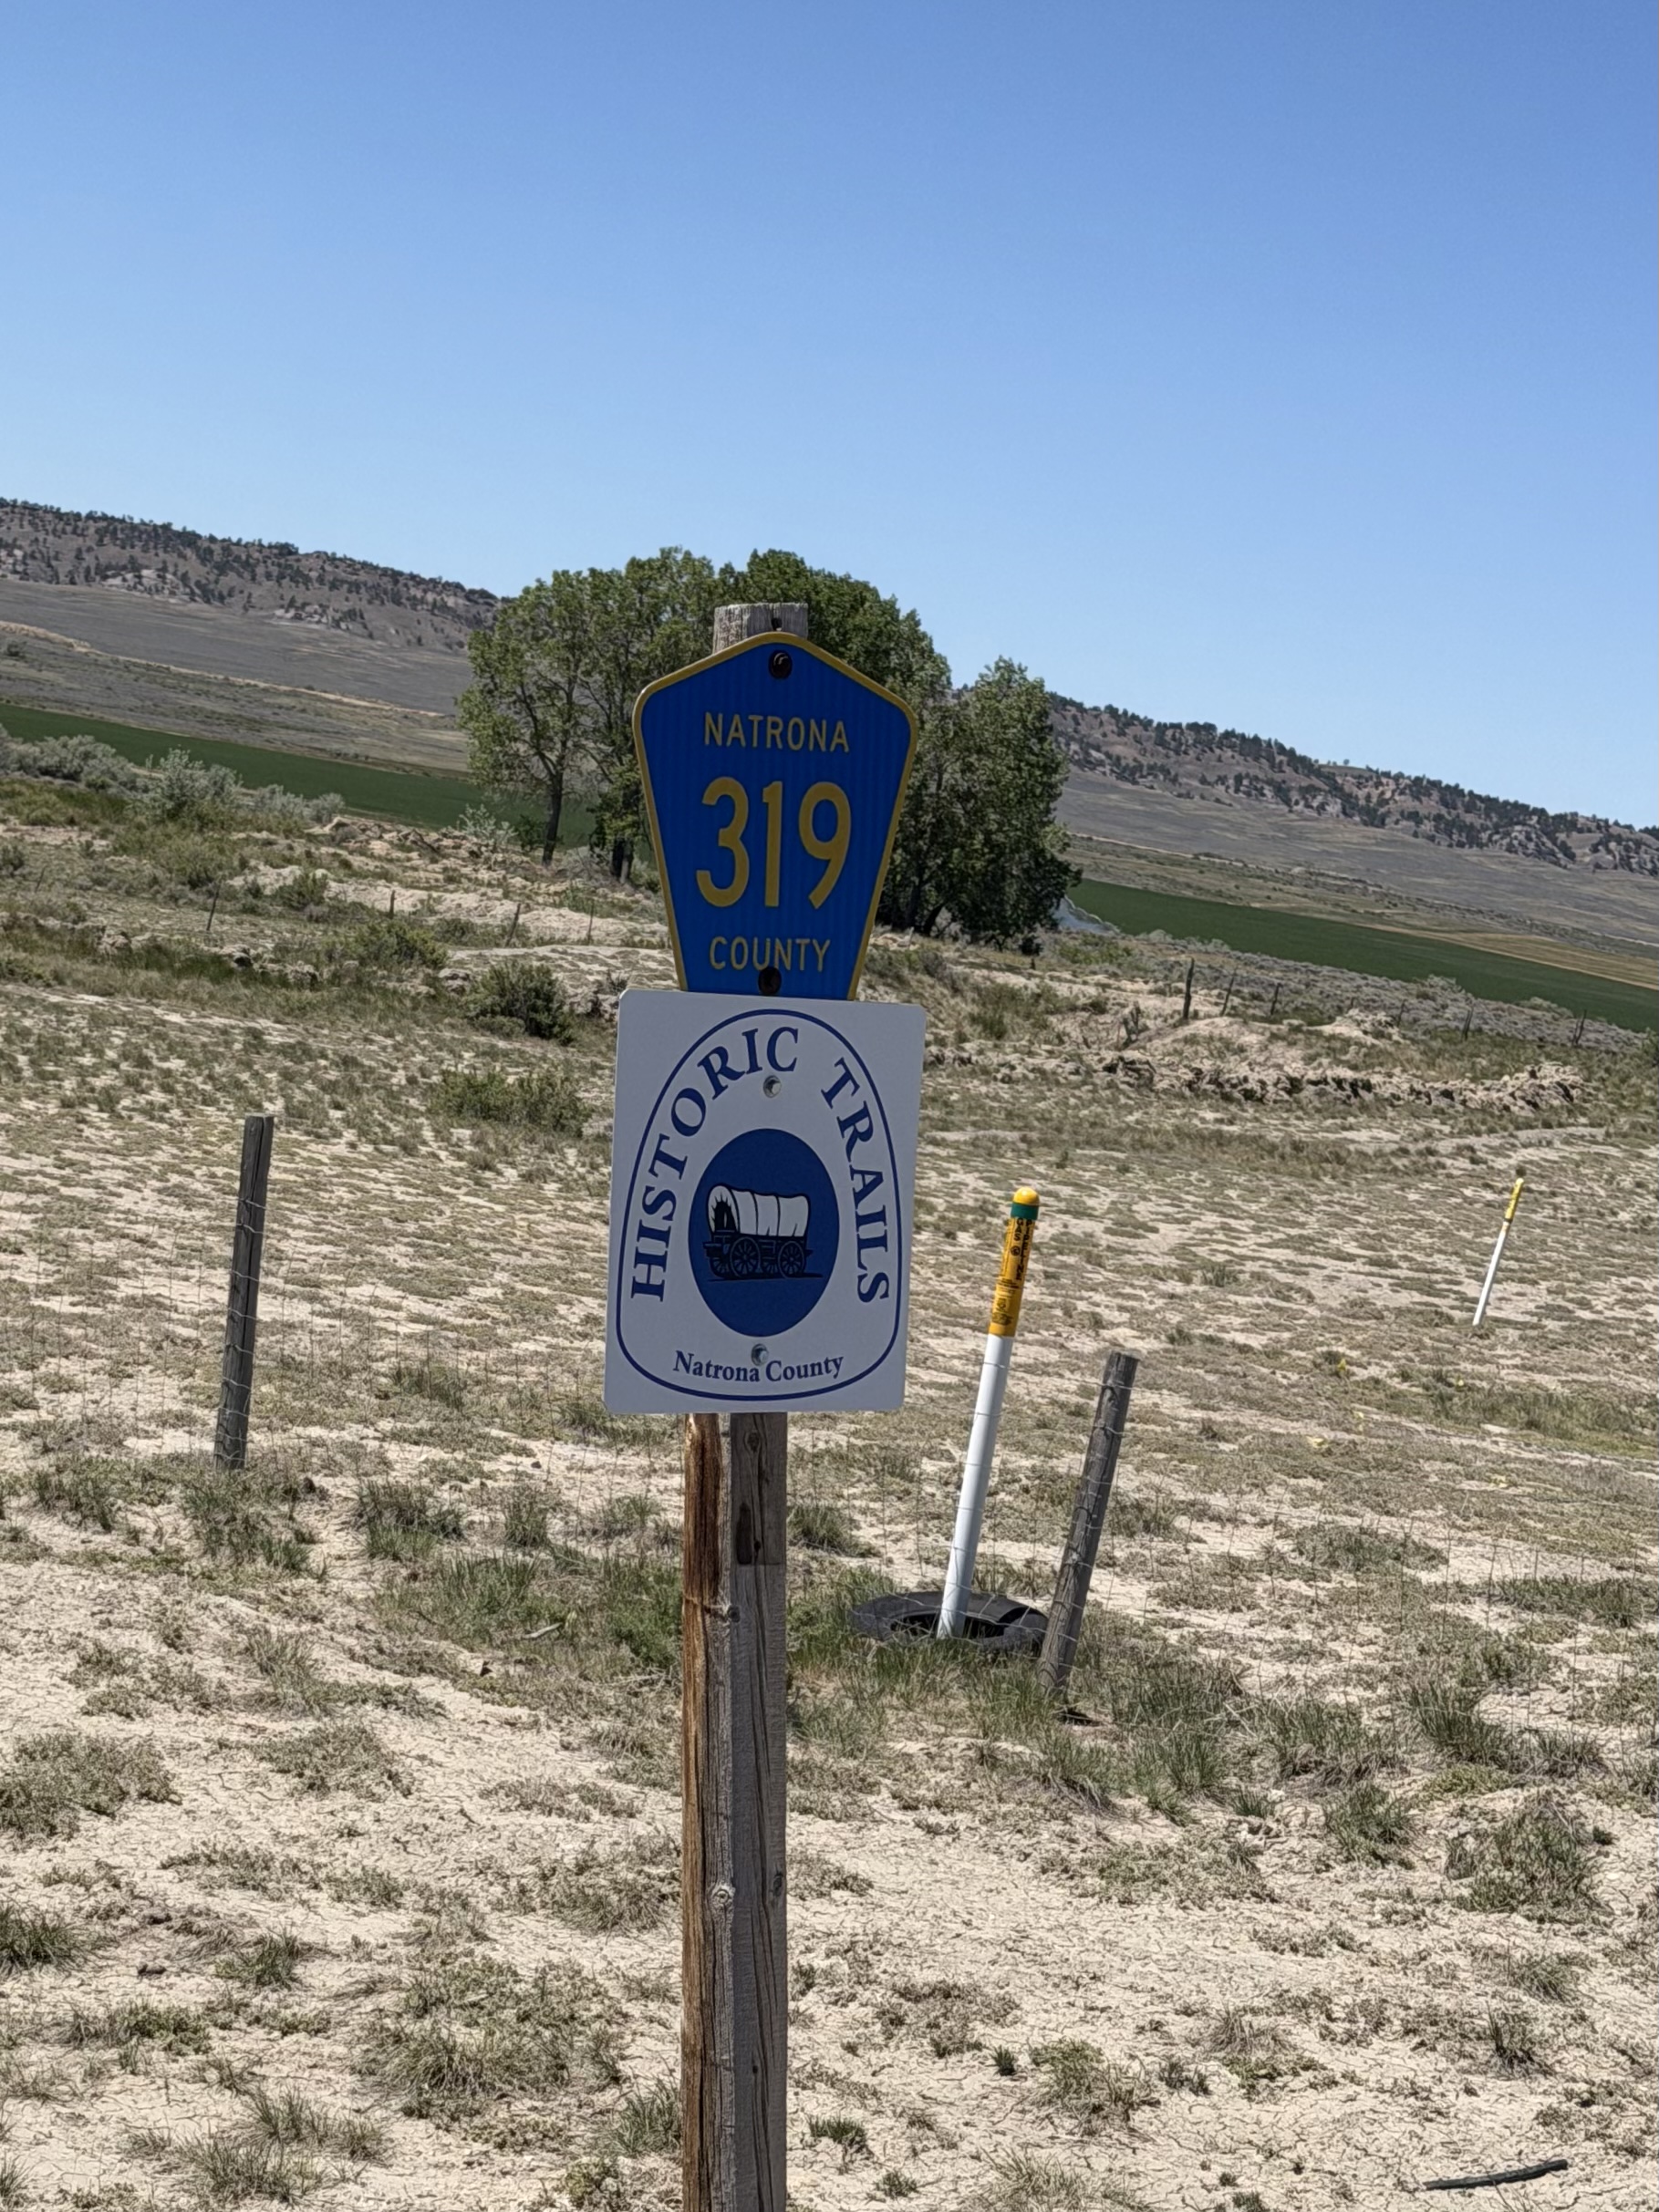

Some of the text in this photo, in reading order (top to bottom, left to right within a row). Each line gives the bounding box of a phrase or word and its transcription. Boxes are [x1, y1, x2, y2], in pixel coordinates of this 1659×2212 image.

[704, 712, 849, 752] NATRONA
[696, 776, 852, 909] 319
[710, 935, 831, 972] COUNTY
[630, 1027, 890, 1304] HISTORIC TRAILS
[1013, 1218, 1024, 1241] GAS
[1016, 1219, 1032, 1280] PIPELINE
[673, 1350, 844, 1382] Natrona County
